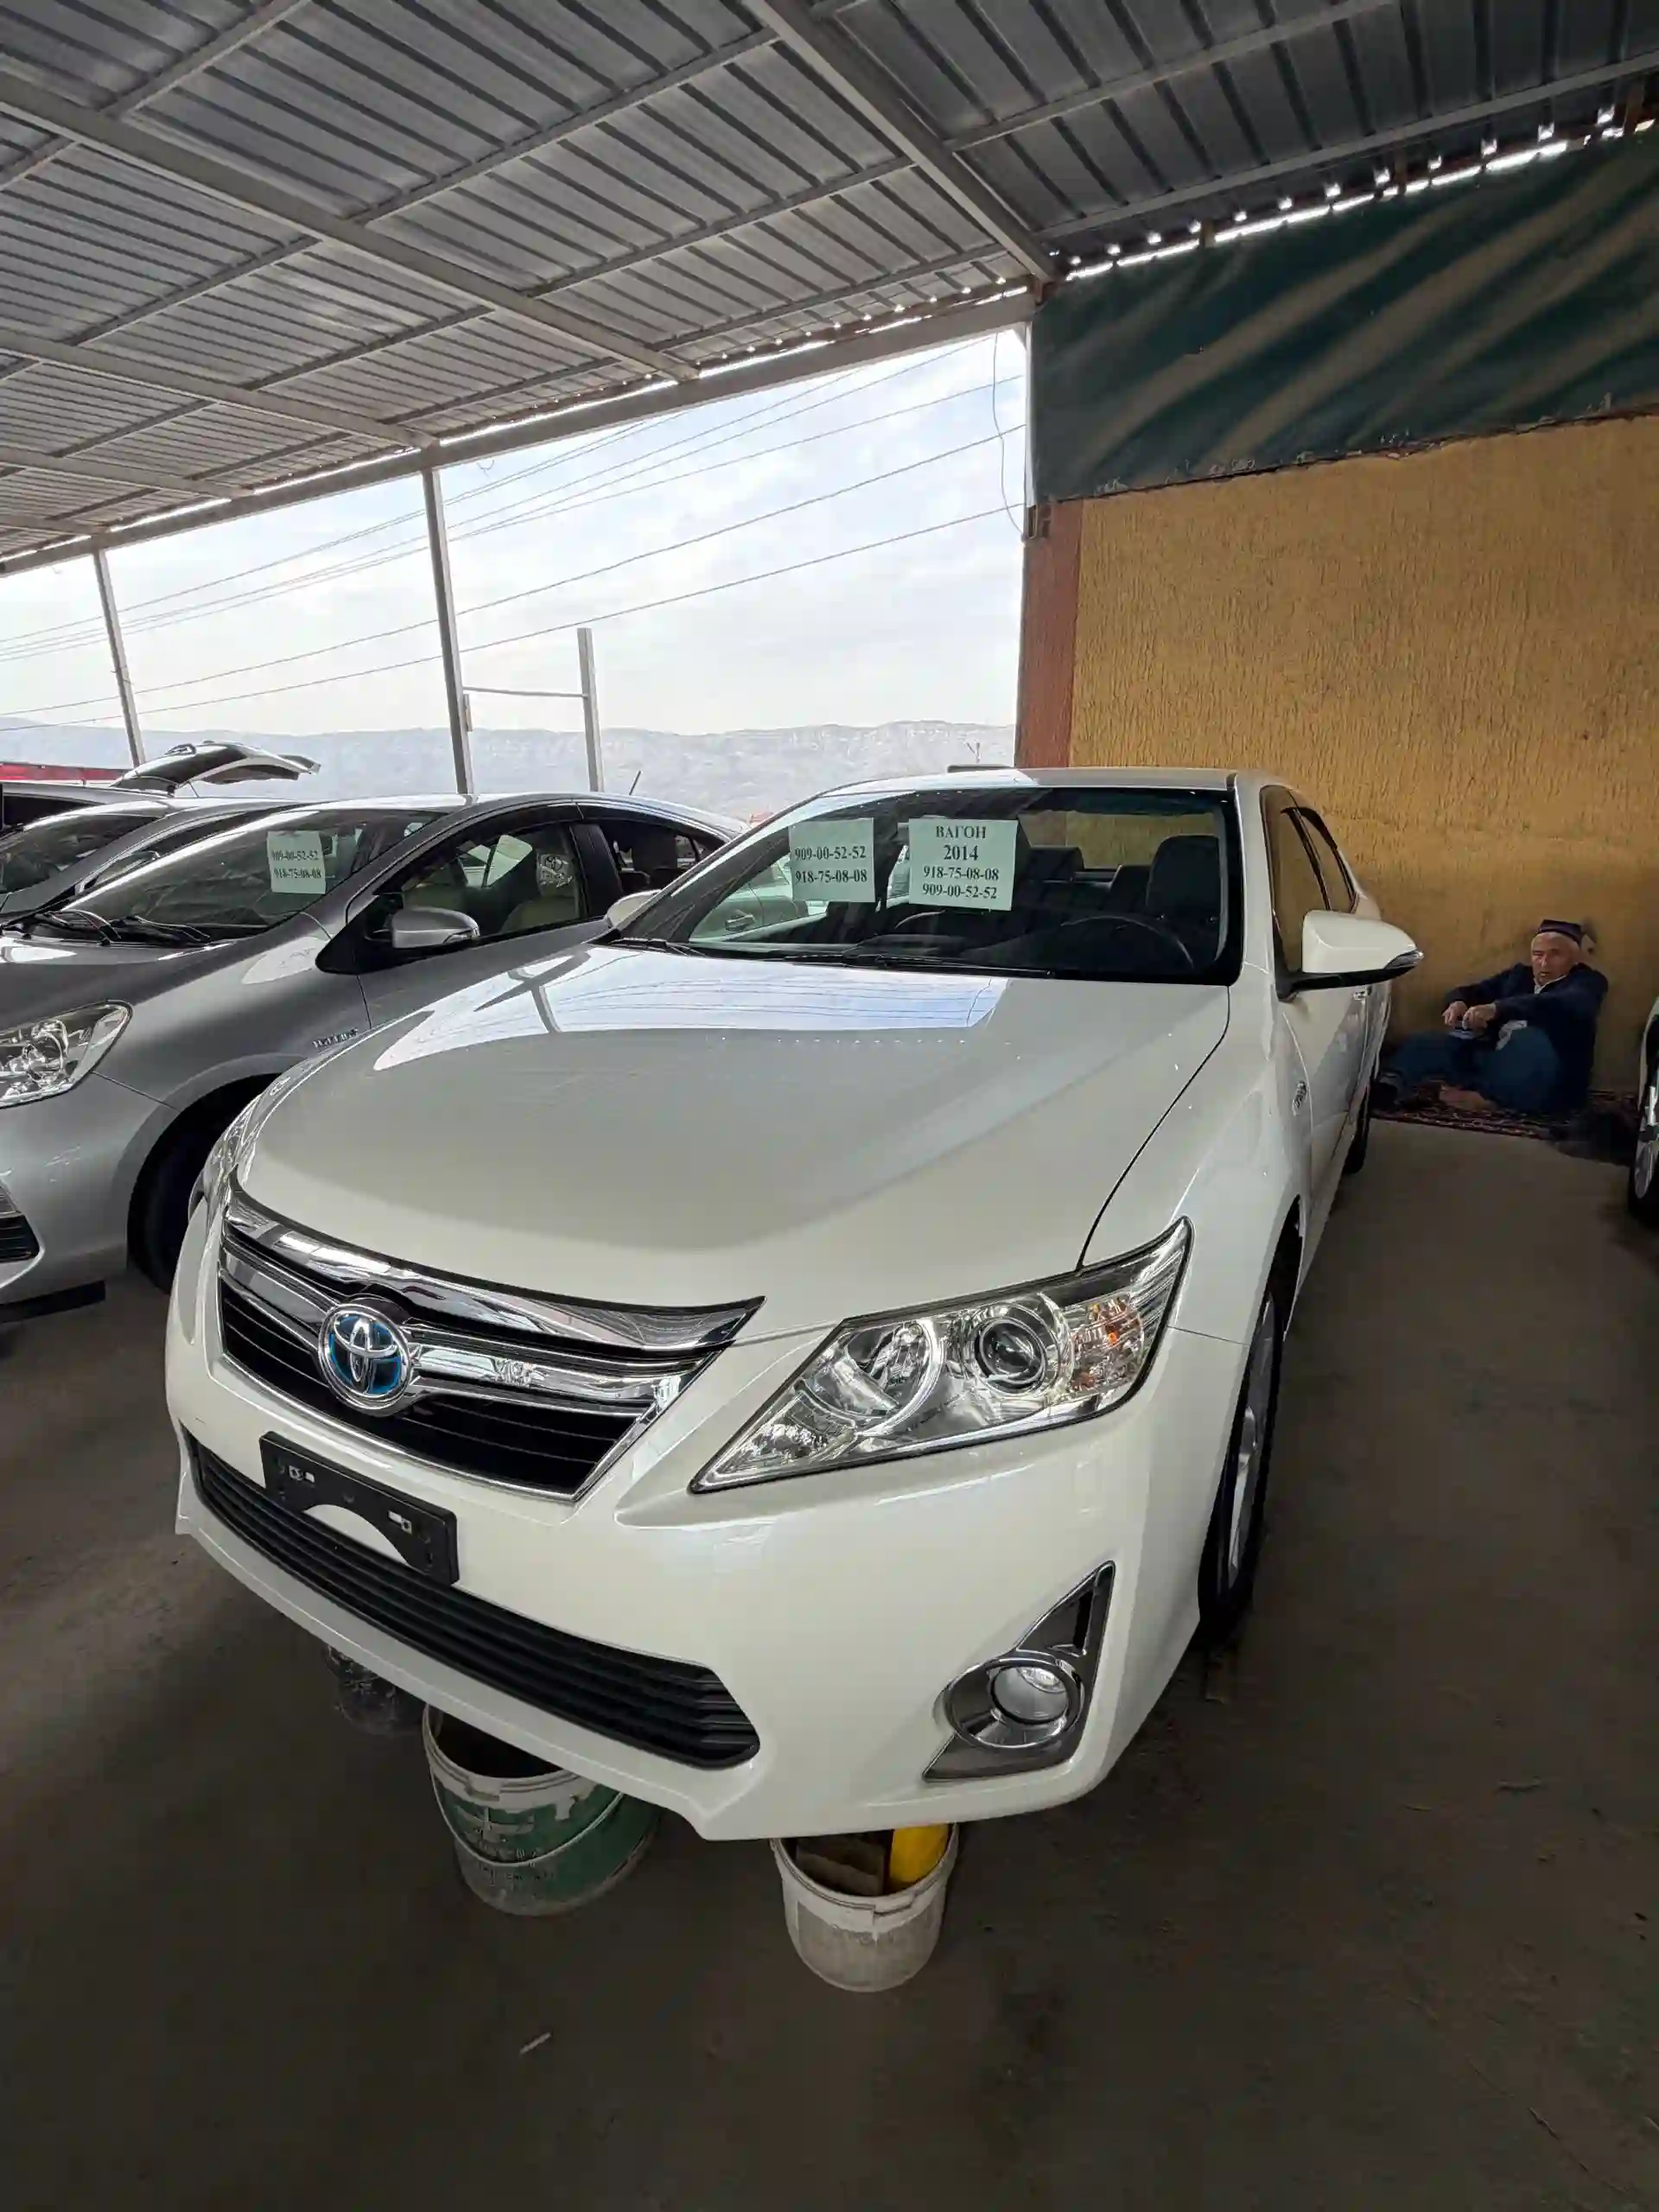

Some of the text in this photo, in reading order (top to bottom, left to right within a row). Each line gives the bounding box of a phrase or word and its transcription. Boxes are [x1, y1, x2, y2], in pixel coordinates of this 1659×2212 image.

[936, 825, 987, 839] ВАГОН
[794, 845, 867, 861] 909-00-52-52
[943, 844, 978, 861] 2014
[795, 868, 868, 884] 918-75-08-08
[923, 865, 1000, 881] 918-75-08-08
[922, 882, 998, 899] 909-00-52-52
